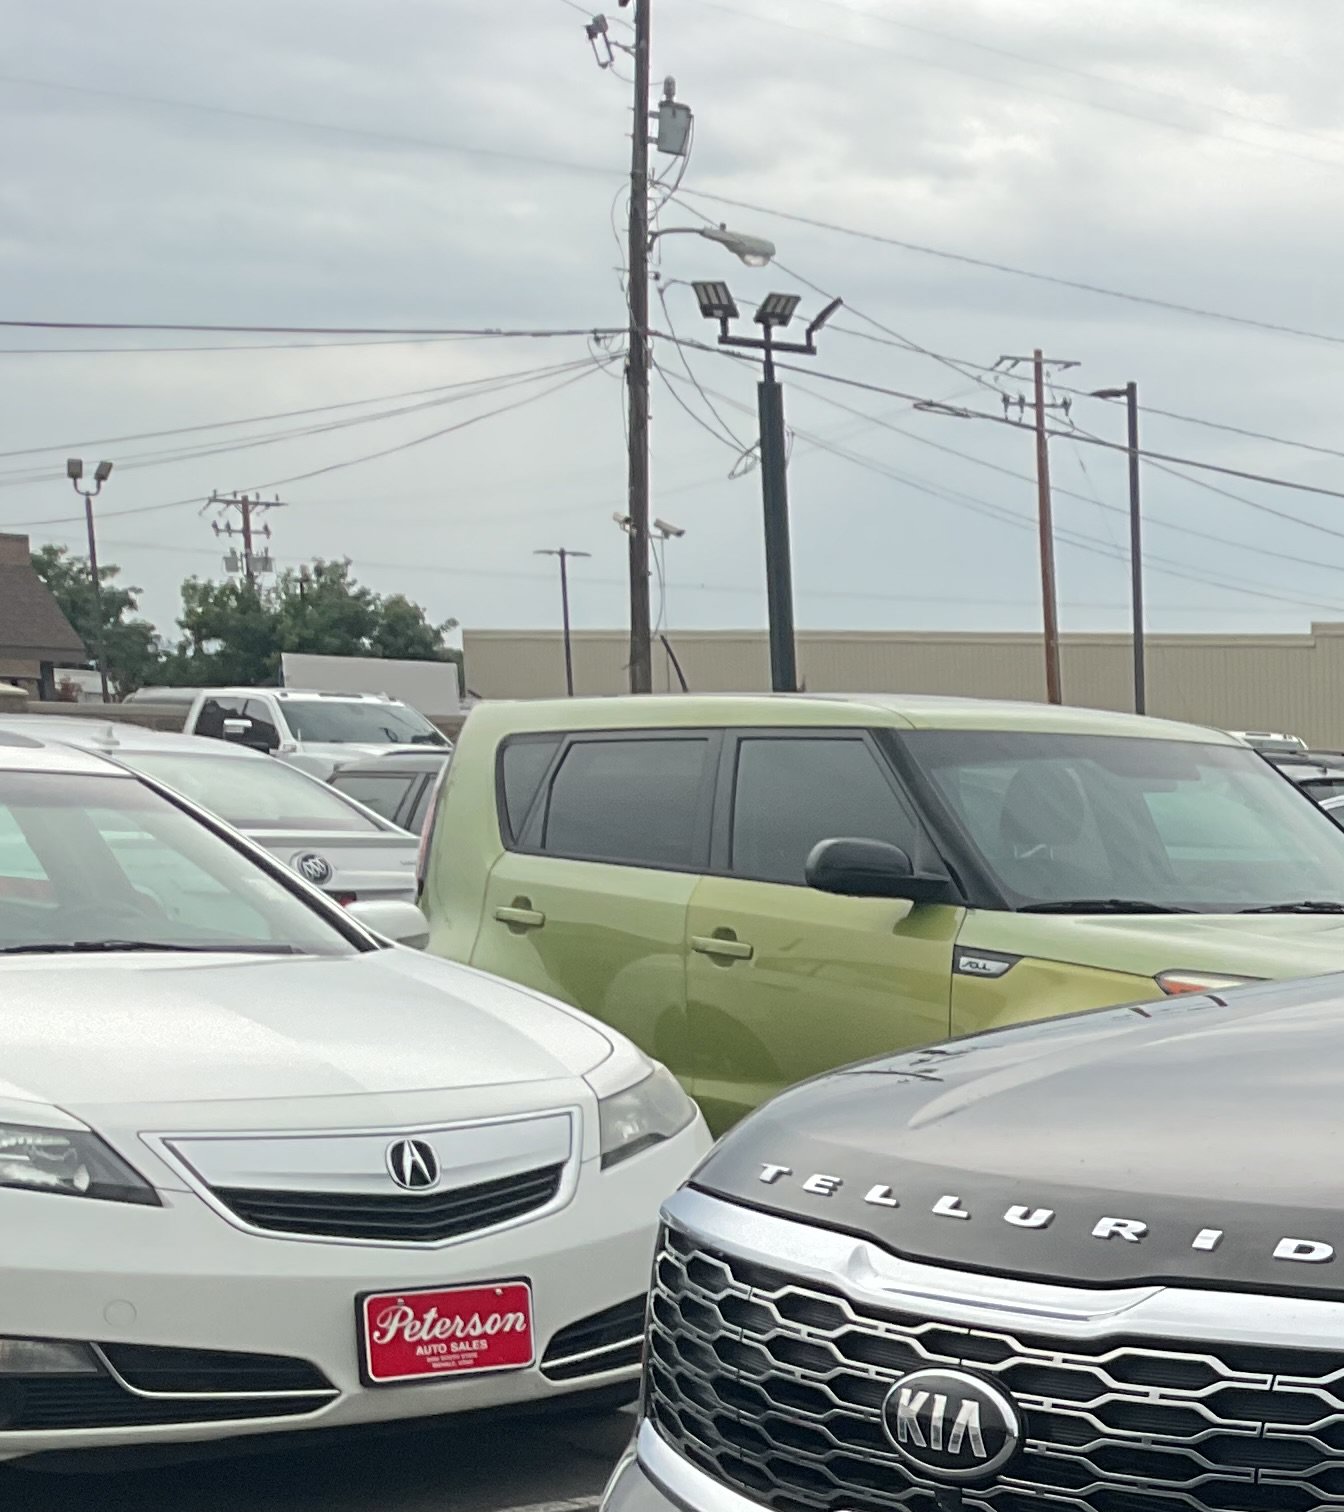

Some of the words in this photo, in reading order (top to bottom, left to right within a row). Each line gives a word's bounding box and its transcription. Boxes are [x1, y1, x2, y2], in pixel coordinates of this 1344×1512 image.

[373, 1305, 527, 1344] Peterson
[416, 1343, 447, 1356] AUTO
[451, 1339, 488, 1353] SALES
[897, 1388, 988, 1459] KIA
